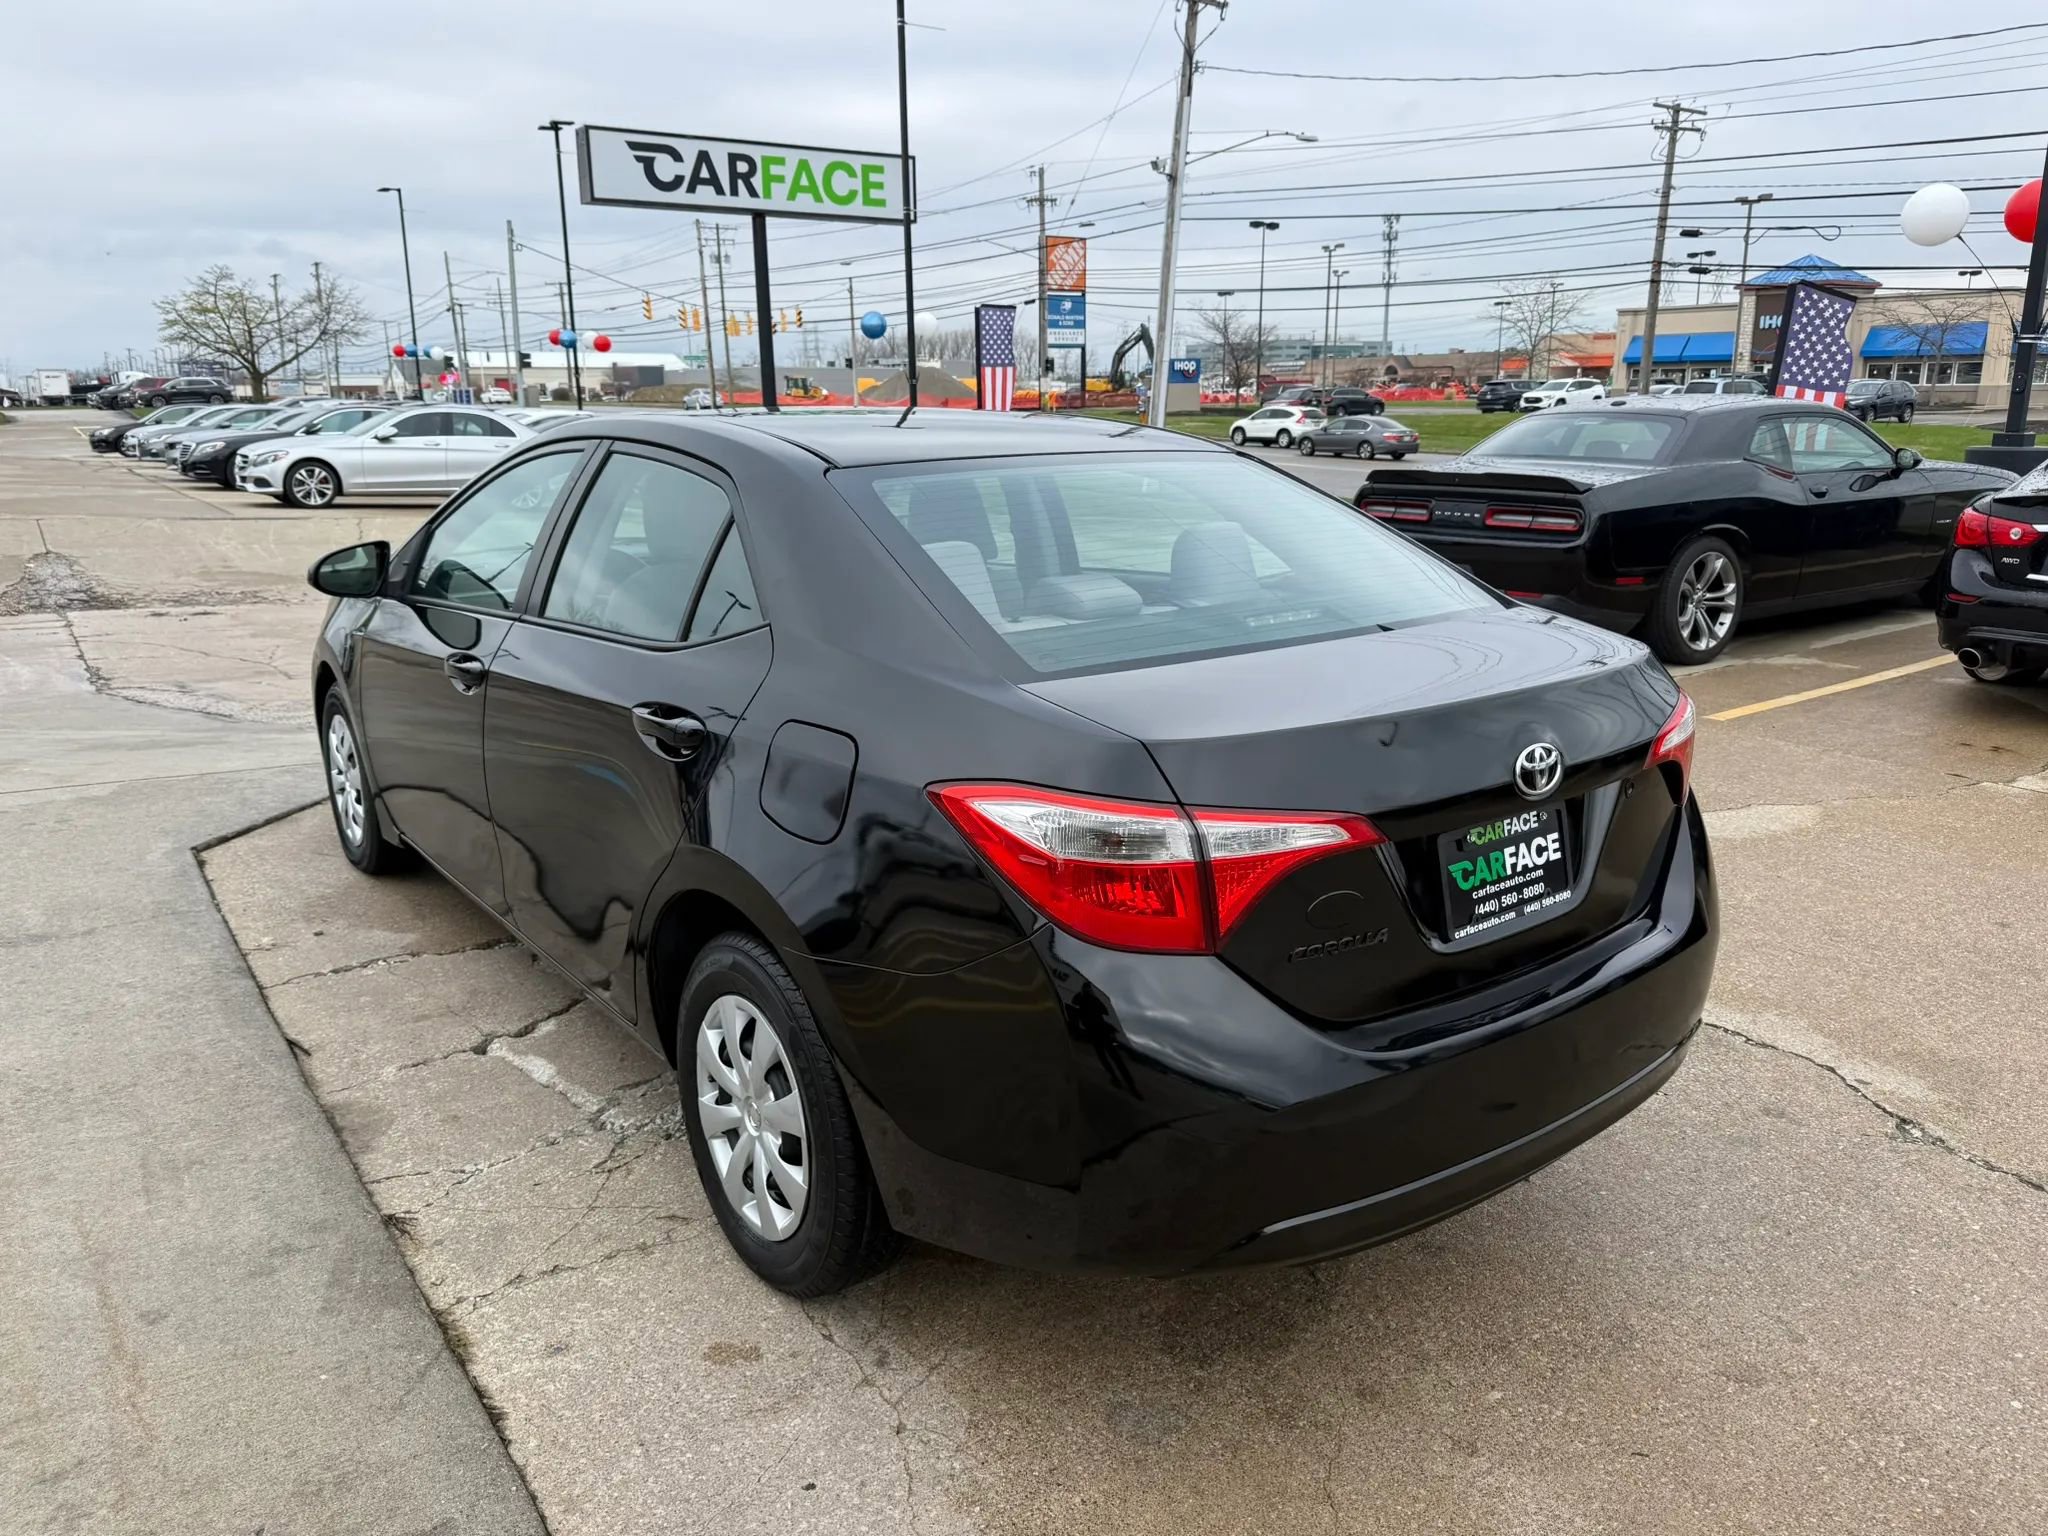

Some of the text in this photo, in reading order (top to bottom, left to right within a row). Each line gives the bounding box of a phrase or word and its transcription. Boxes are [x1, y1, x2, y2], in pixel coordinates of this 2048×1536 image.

[624, 140, 887, 208] CARFACE
[2001, 557, 2020, 565] AWD
[1469, 811, 1539, 846] CARFACE
[1447, 832, 1562, 891] CARFACE
[1472, 868, 1544, 900] carfaceauto.com
[1454, 890, 1572, 939] carfaceauto.com (440) 560-8080
[1475, 898, 1499, 915] (440)
[1289, 928, 1389, 962] COROLLA
